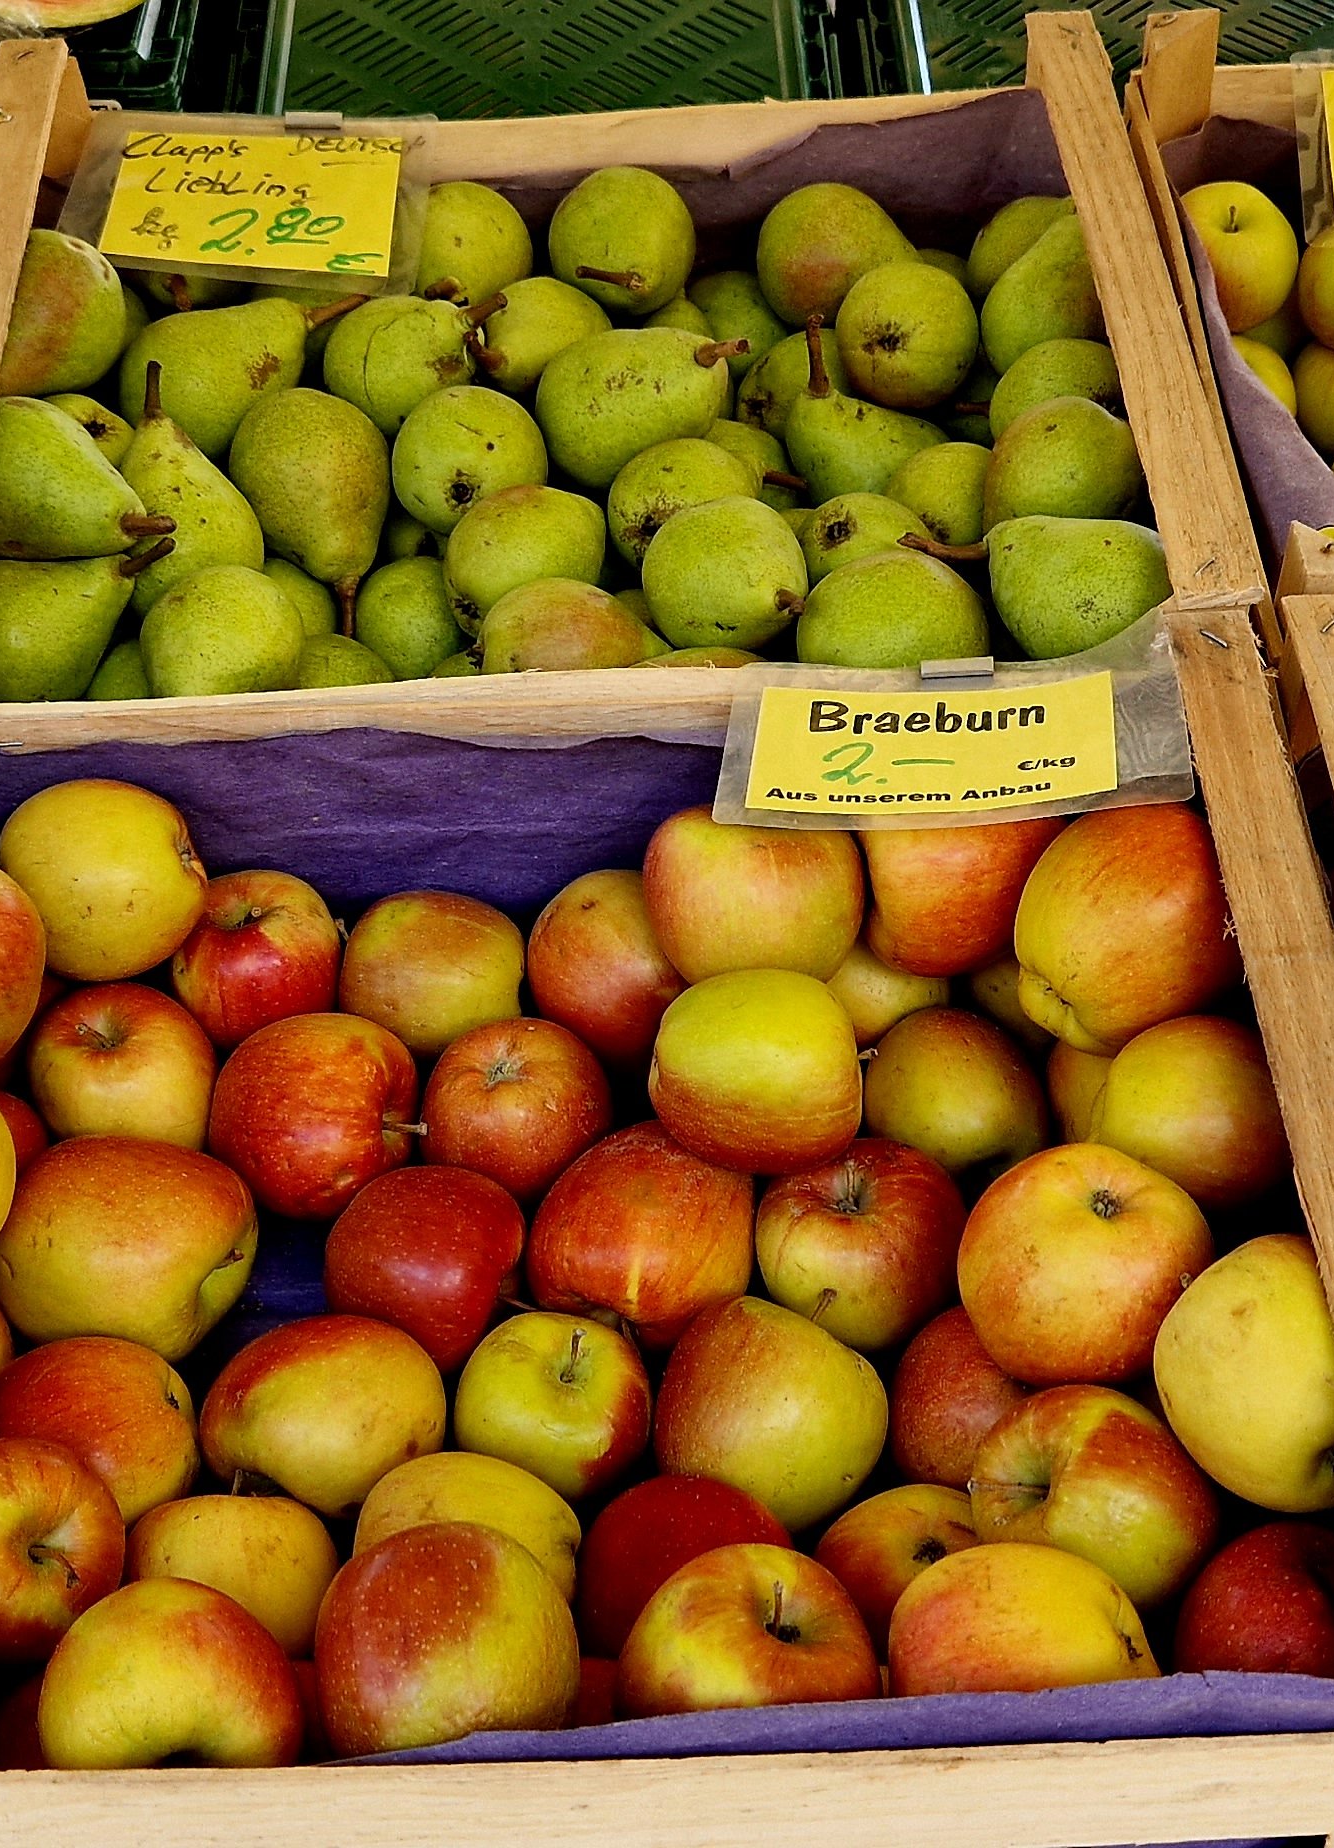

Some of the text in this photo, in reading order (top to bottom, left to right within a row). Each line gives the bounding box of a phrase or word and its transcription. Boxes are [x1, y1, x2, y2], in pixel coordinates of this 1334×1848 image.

[121, 133, 249, 164] Clapp's
[810, 700, 1045, 735] Braeburn
[1017, 755, 1076, 772] €/kg
[766, 781, 1051, 804] Aus unserem Anbau
